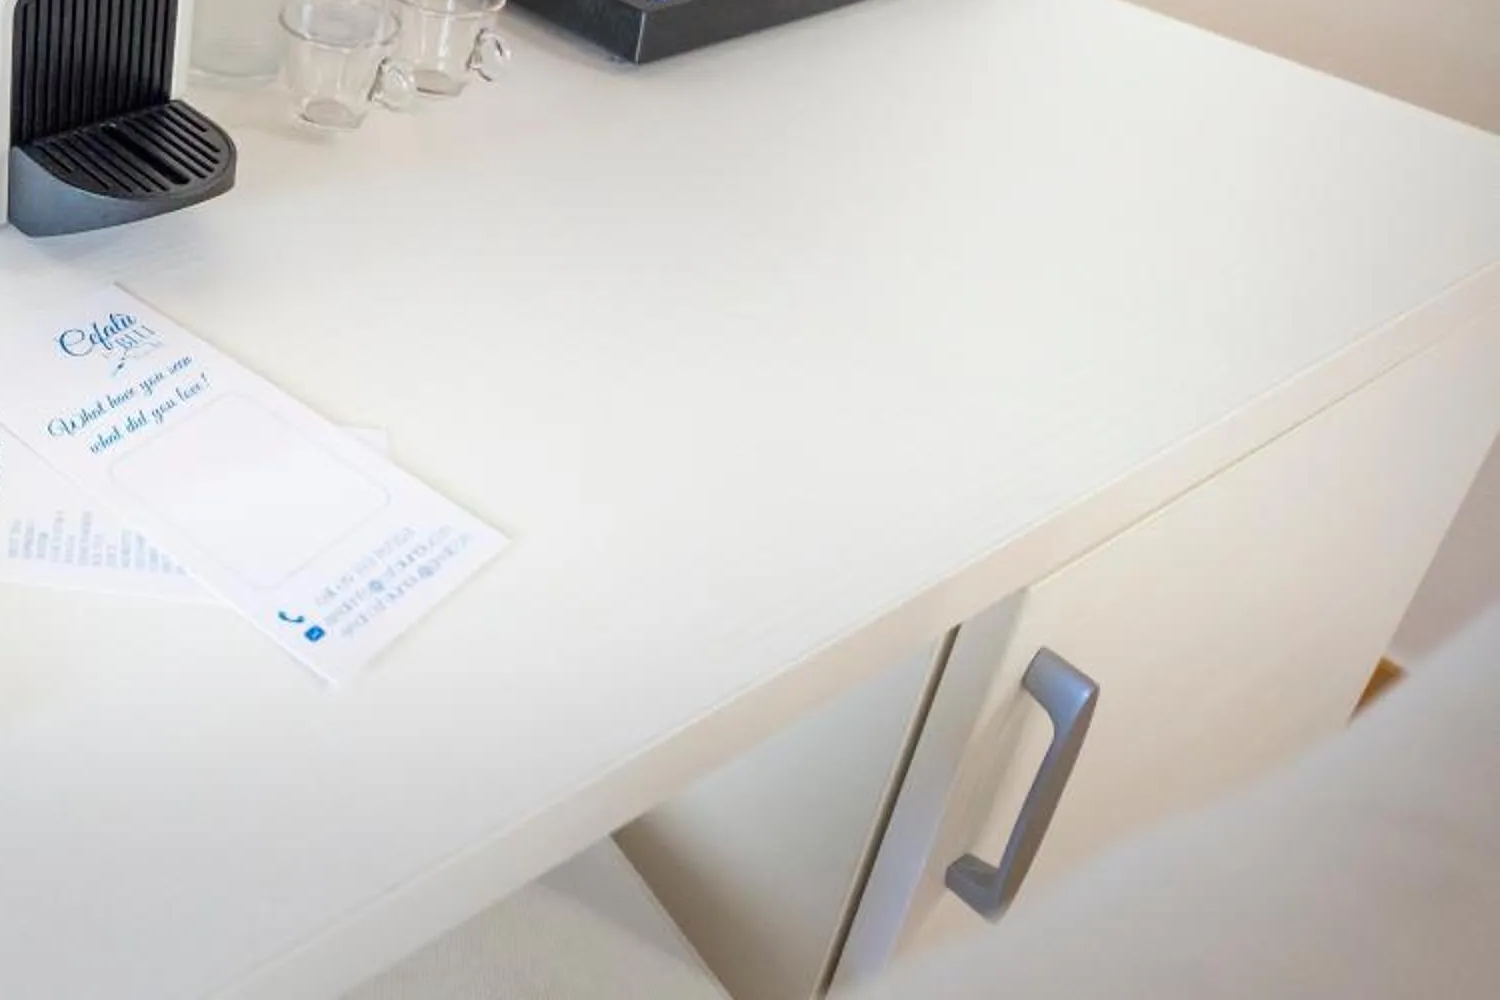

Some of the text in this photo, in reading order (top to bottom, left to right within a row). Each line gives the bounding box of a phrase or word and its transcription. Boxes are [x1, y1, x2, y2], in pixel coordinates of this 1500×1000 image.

[47, 401, 108, 437] What
[107, 387, 135, 409] have
[139, 371, 165, 397] you
[90, 425, 122, 455] what
[125, 409, 149, 433] did
[151, 399, 178, 425] you
